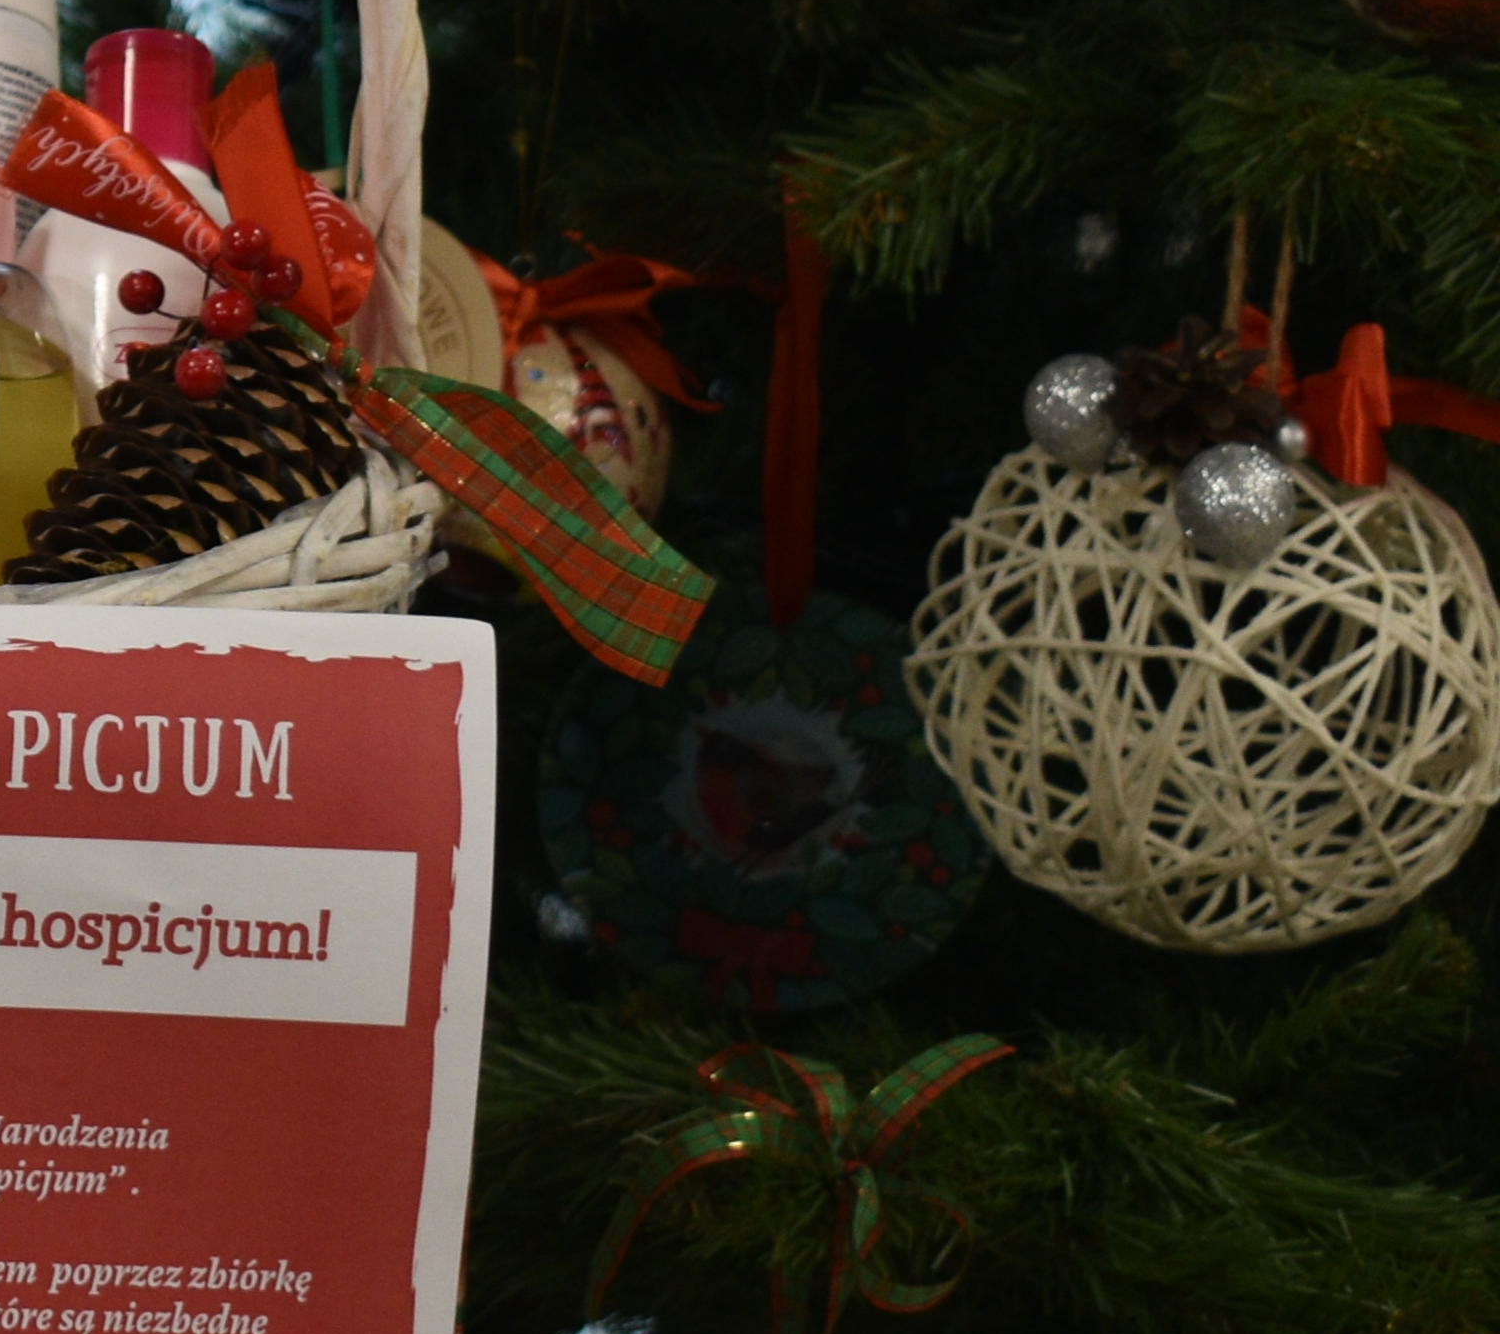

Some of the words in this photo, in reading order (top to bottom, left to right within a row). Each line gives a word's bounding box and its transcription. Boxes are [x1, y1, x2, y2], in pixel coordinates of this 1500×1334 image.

[29, 123, 220, 259] Wesołych
[48, 1262, 184, 1296] poprzez
[187, 1256, 313, 1303] zbiórkę
